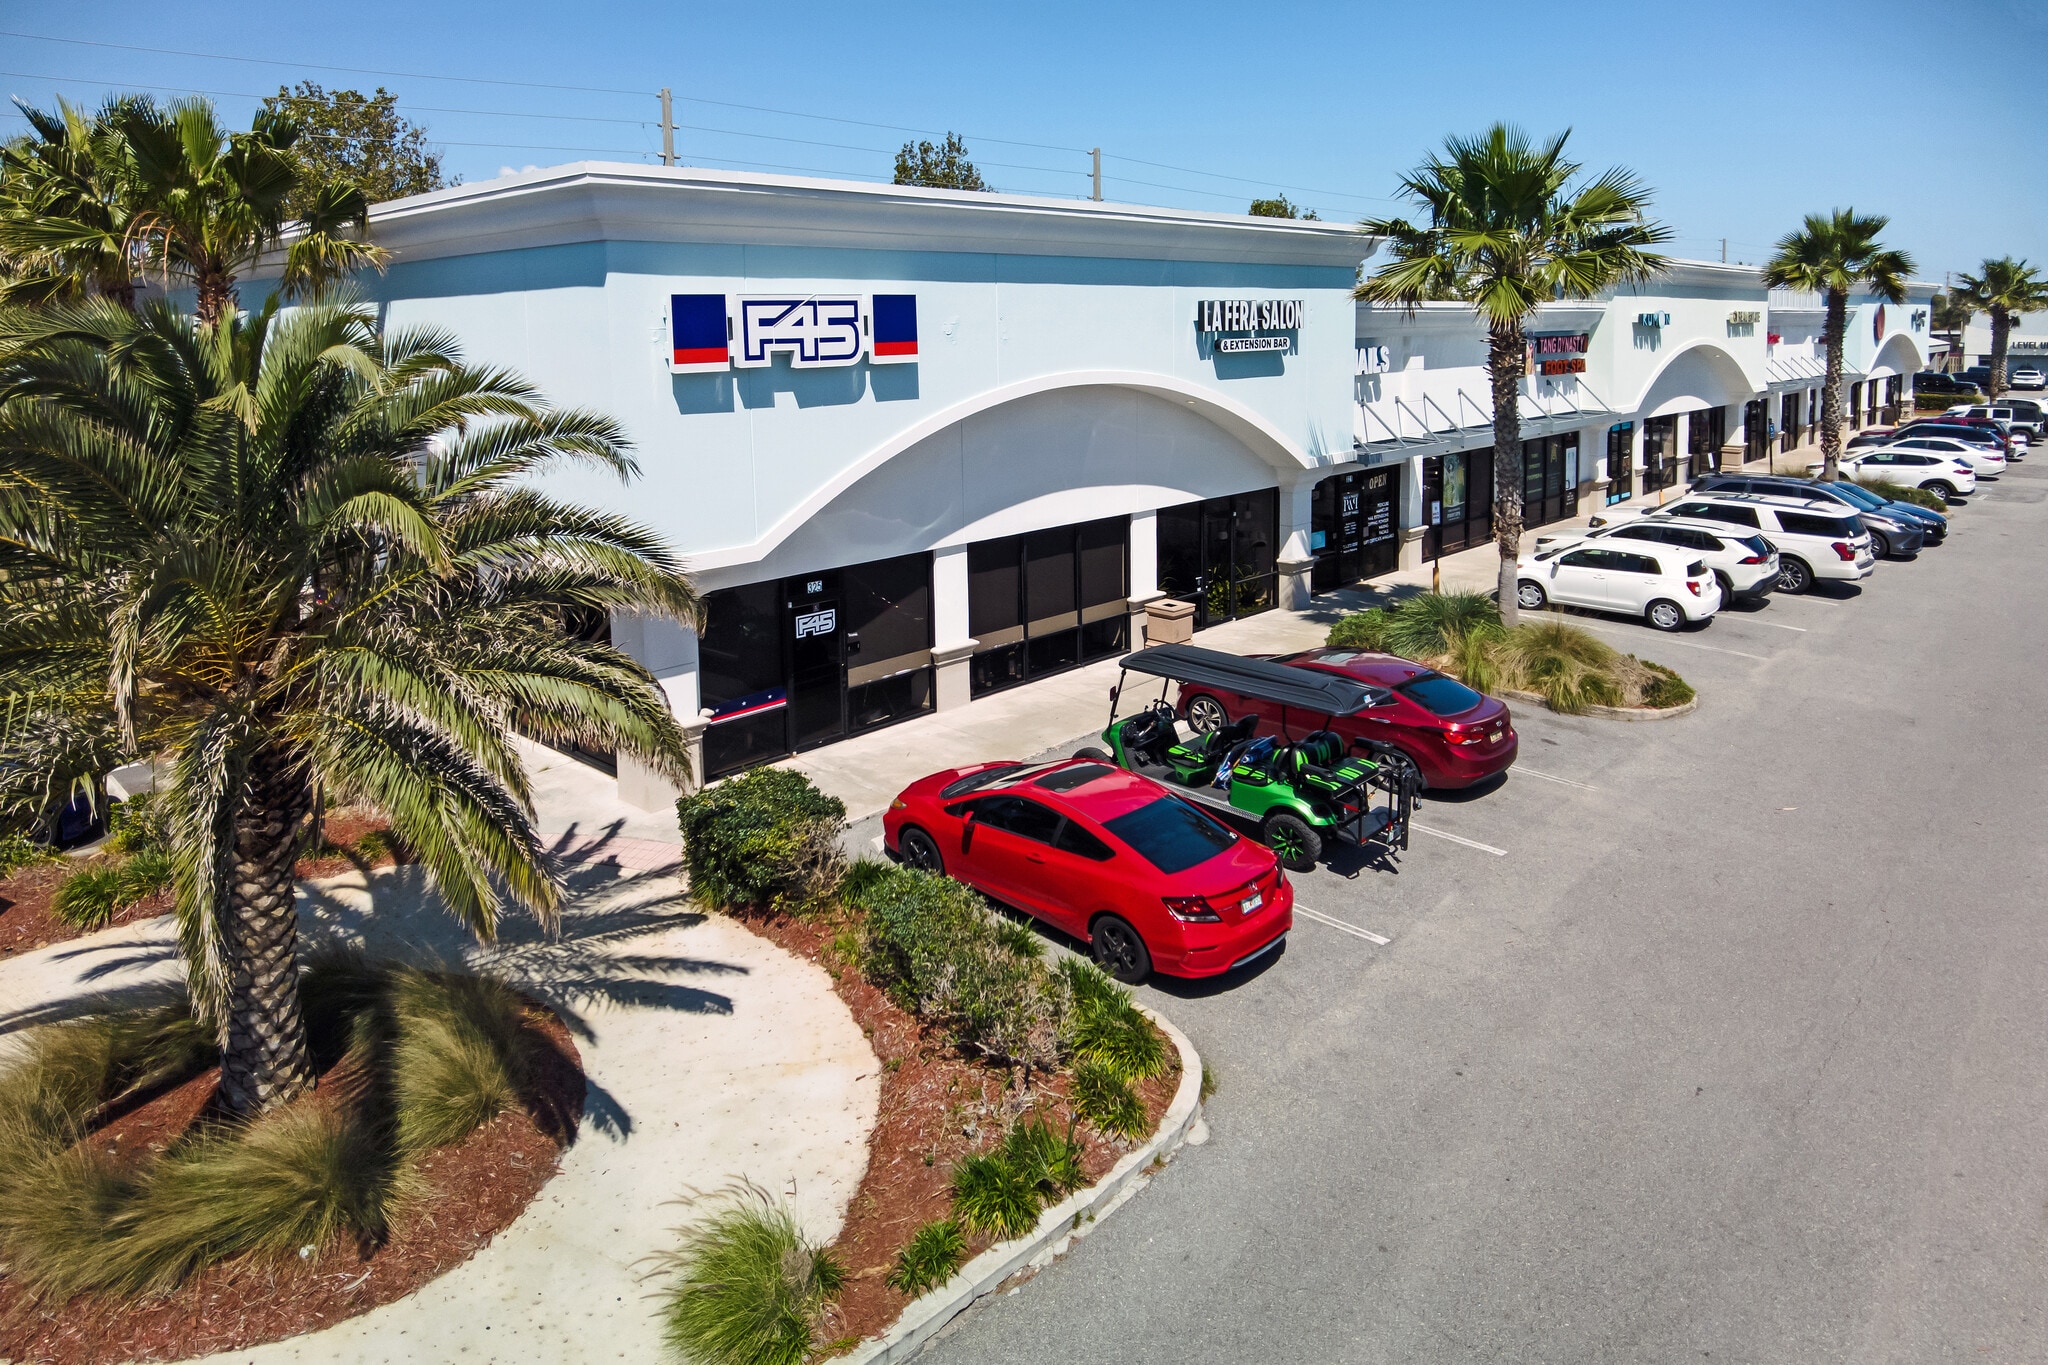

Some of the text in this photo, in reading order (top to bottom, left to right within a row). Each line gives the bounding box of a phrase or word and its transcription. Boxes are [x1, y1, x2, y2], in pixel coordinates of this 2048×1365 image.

[1203, 300, 1305, 331] LA FERA SALON
[1641, 310, 1671, 329] KUMON
[738, 297, 862, 364] F45
[1222, 338, 1288, 351] & EXTENSION BAR
[1540, 335, 1585, 354] TANG DYNASTY
[2012, 341, 2048, 350] LEVEL U
[1545, 358, 1586, 376] FOOT SPA
[1368, 473, 1388, 490] OPEN
[807, 581, 822, 593] 325
[797, 610, 836, 638] F45
